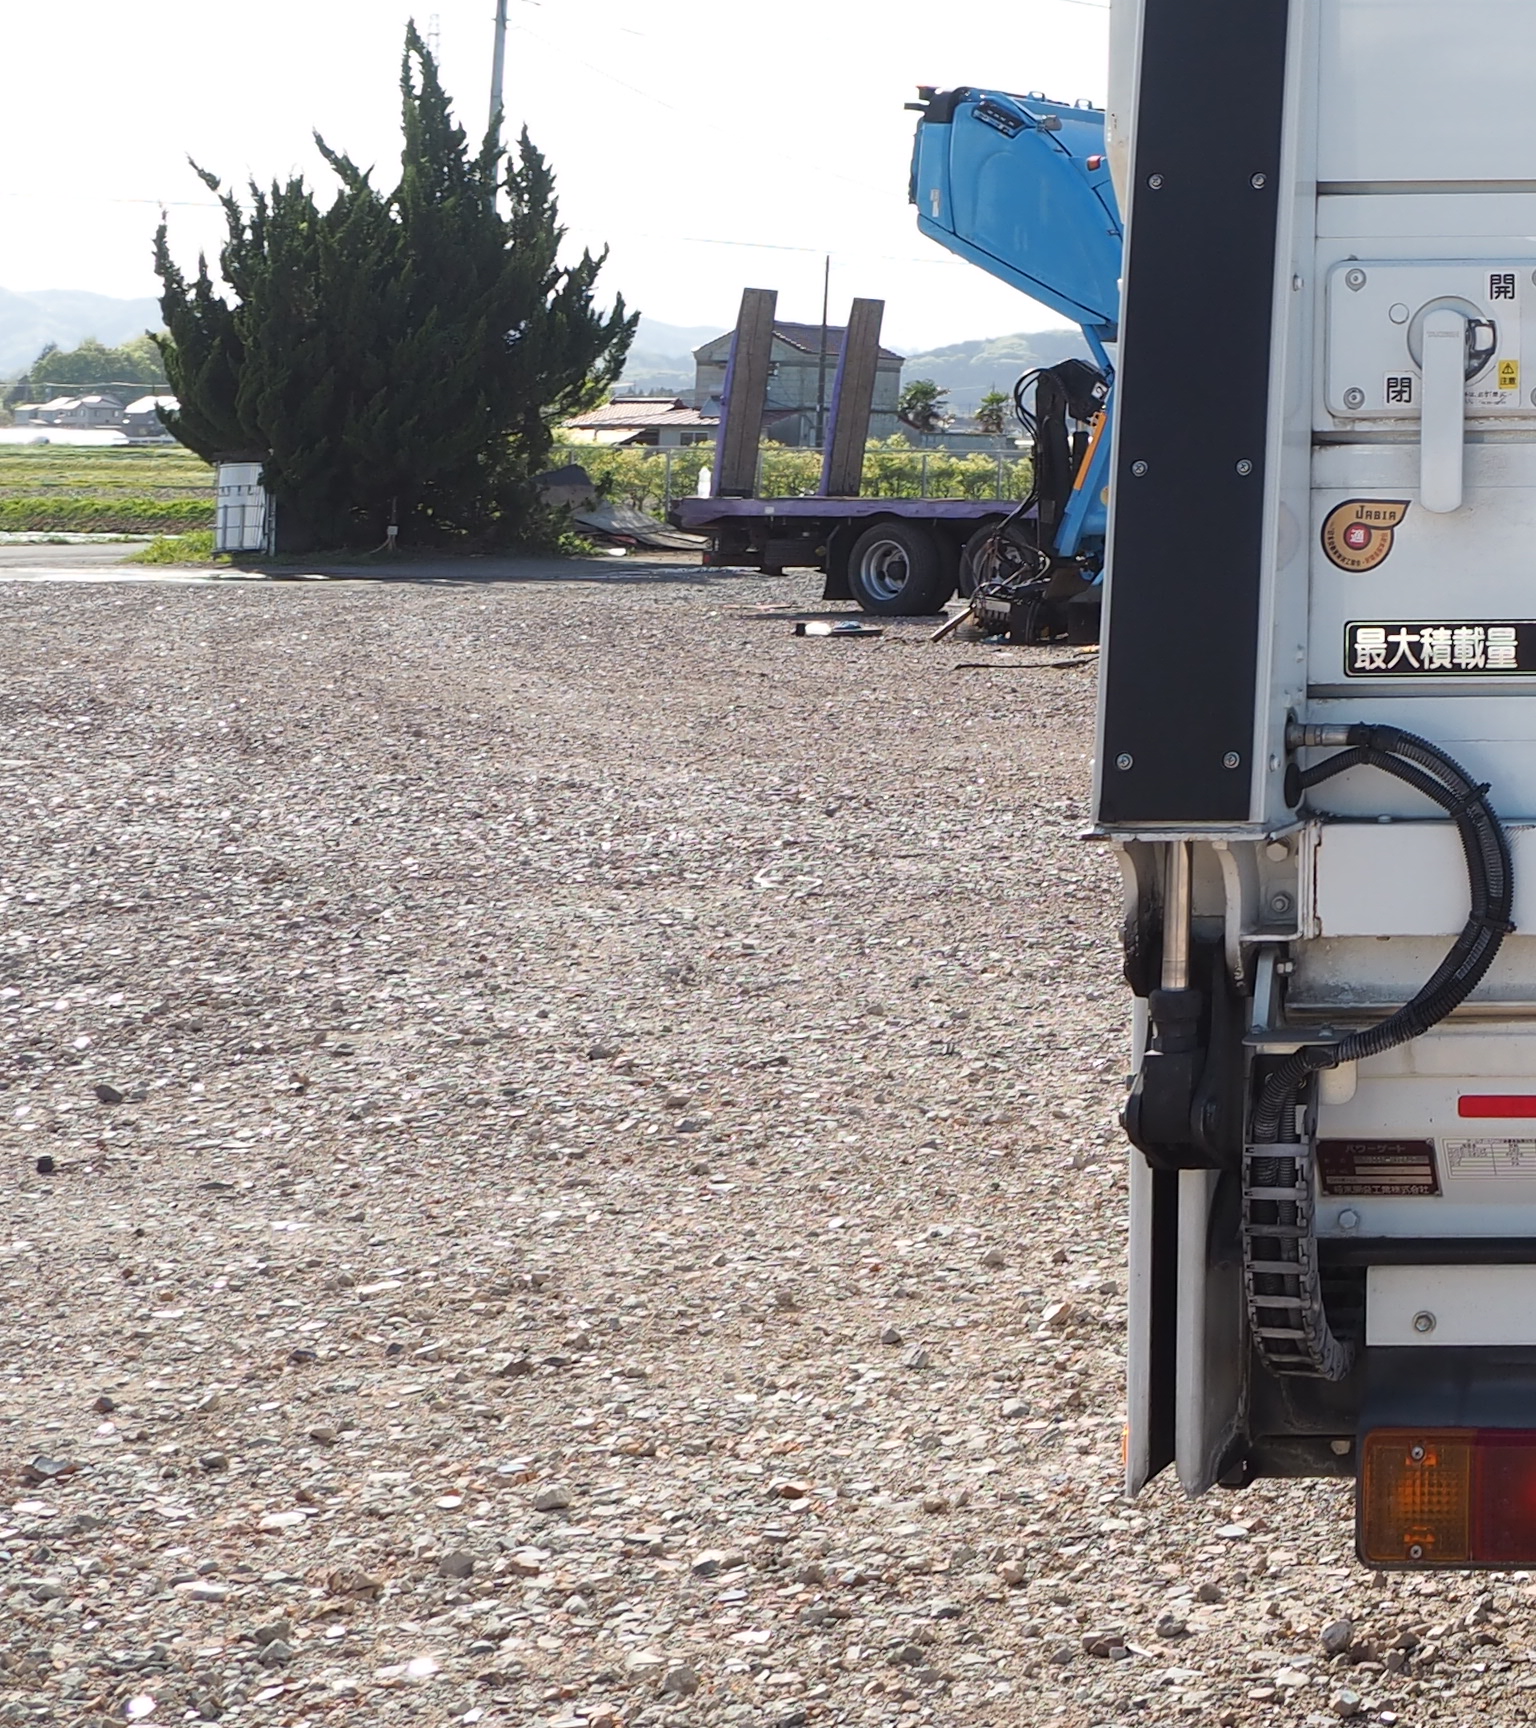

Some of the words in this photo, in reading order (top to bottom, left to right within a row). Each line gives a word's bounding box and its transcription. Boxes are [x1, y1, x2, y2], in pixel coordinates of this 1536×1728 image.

[1490, 273, 1515, 300] 開
[1386, 377, 1412, 403] 閉
[1500, 377, 1517, 385] 注意
[1355, 505, 1397, 520] JABIA
[1354, 626, 1518, 670] 最大積載量
